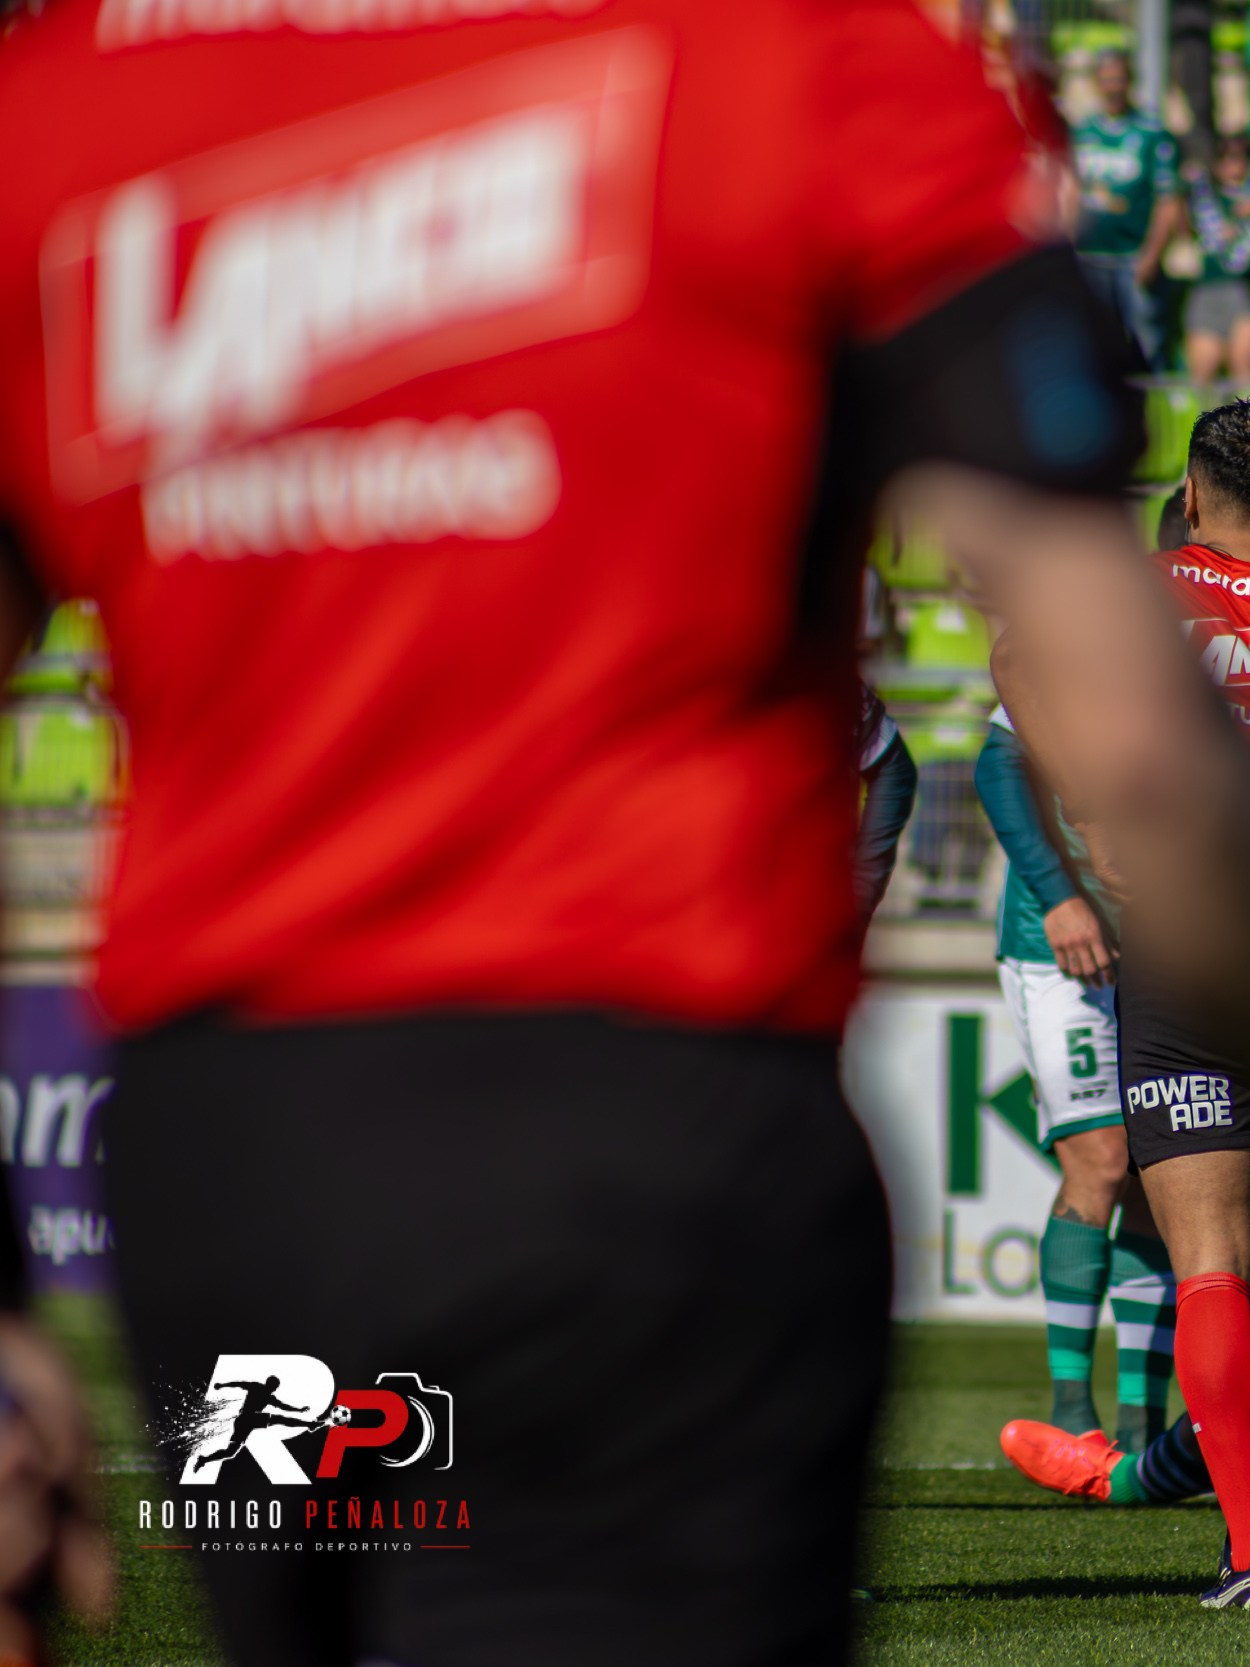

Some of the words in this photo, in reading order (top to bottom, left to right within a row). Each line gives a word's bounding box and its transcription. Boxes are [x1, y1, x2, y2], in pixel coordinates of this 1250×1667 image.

[1065, 1027, 1097, 1079] 5
[1127, 1075, 1230, 1115] POWER
[1170, 1100, 1233, 1132] ADE
